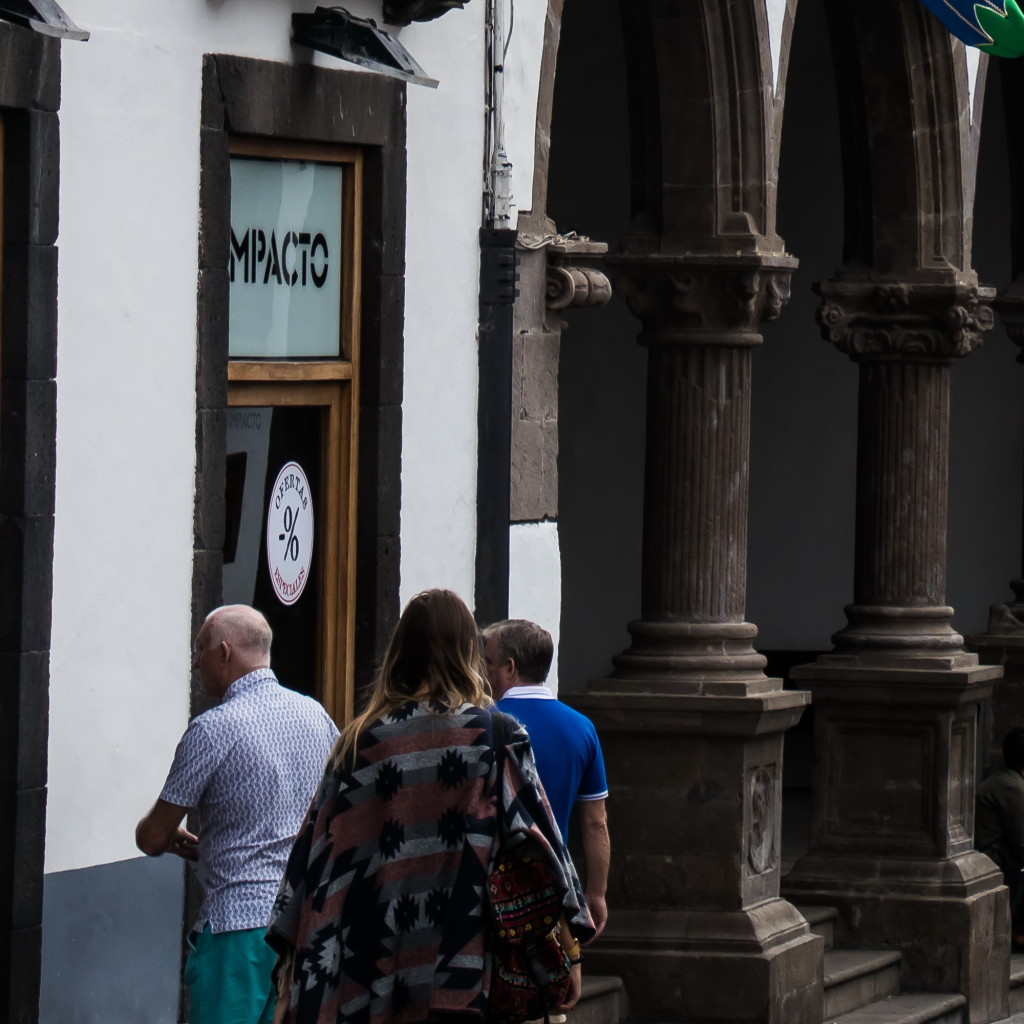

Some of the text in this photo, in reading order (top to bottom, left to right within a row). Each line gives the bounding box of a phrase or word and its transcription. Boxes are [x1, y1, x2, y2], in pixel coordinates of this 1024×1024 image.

[230, 227, 329, 288] MPACTO
[275, 474, 308, 510] OFERTAS
[274, 565, 305, 596] ESPECIALES
